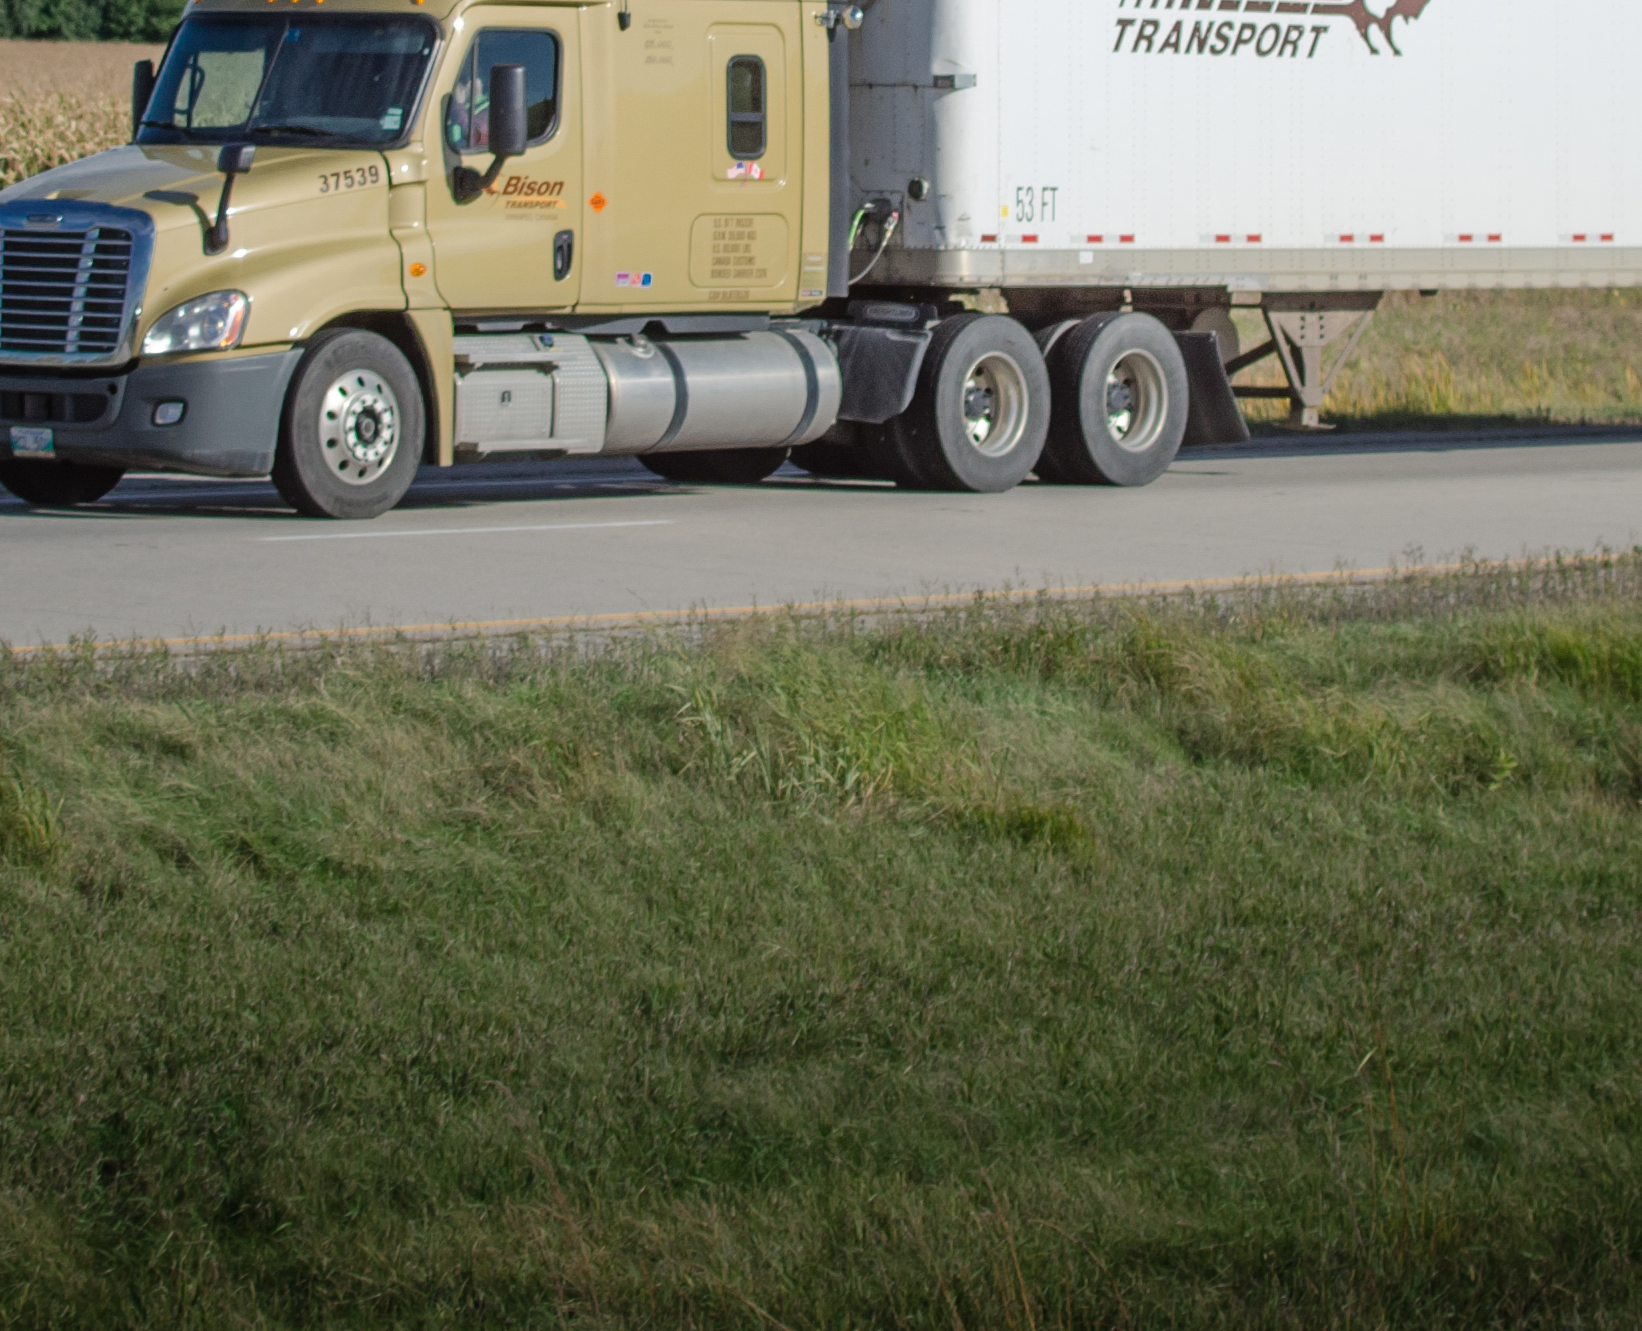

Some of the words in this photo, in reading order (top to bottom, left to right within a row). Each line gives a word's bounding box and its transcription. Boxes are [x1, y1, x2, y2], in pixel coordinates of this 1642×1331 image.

[1112, 18, 1330, 59] TRANSPORT
[318, 164, 380, 194] 37539
[502, 175, 565, 197] Bison
[504, 200, 559, 209] TRANSPORT
[1016, 186, 1035, 223] 53
[1041, 186, 1059, 223] FT
